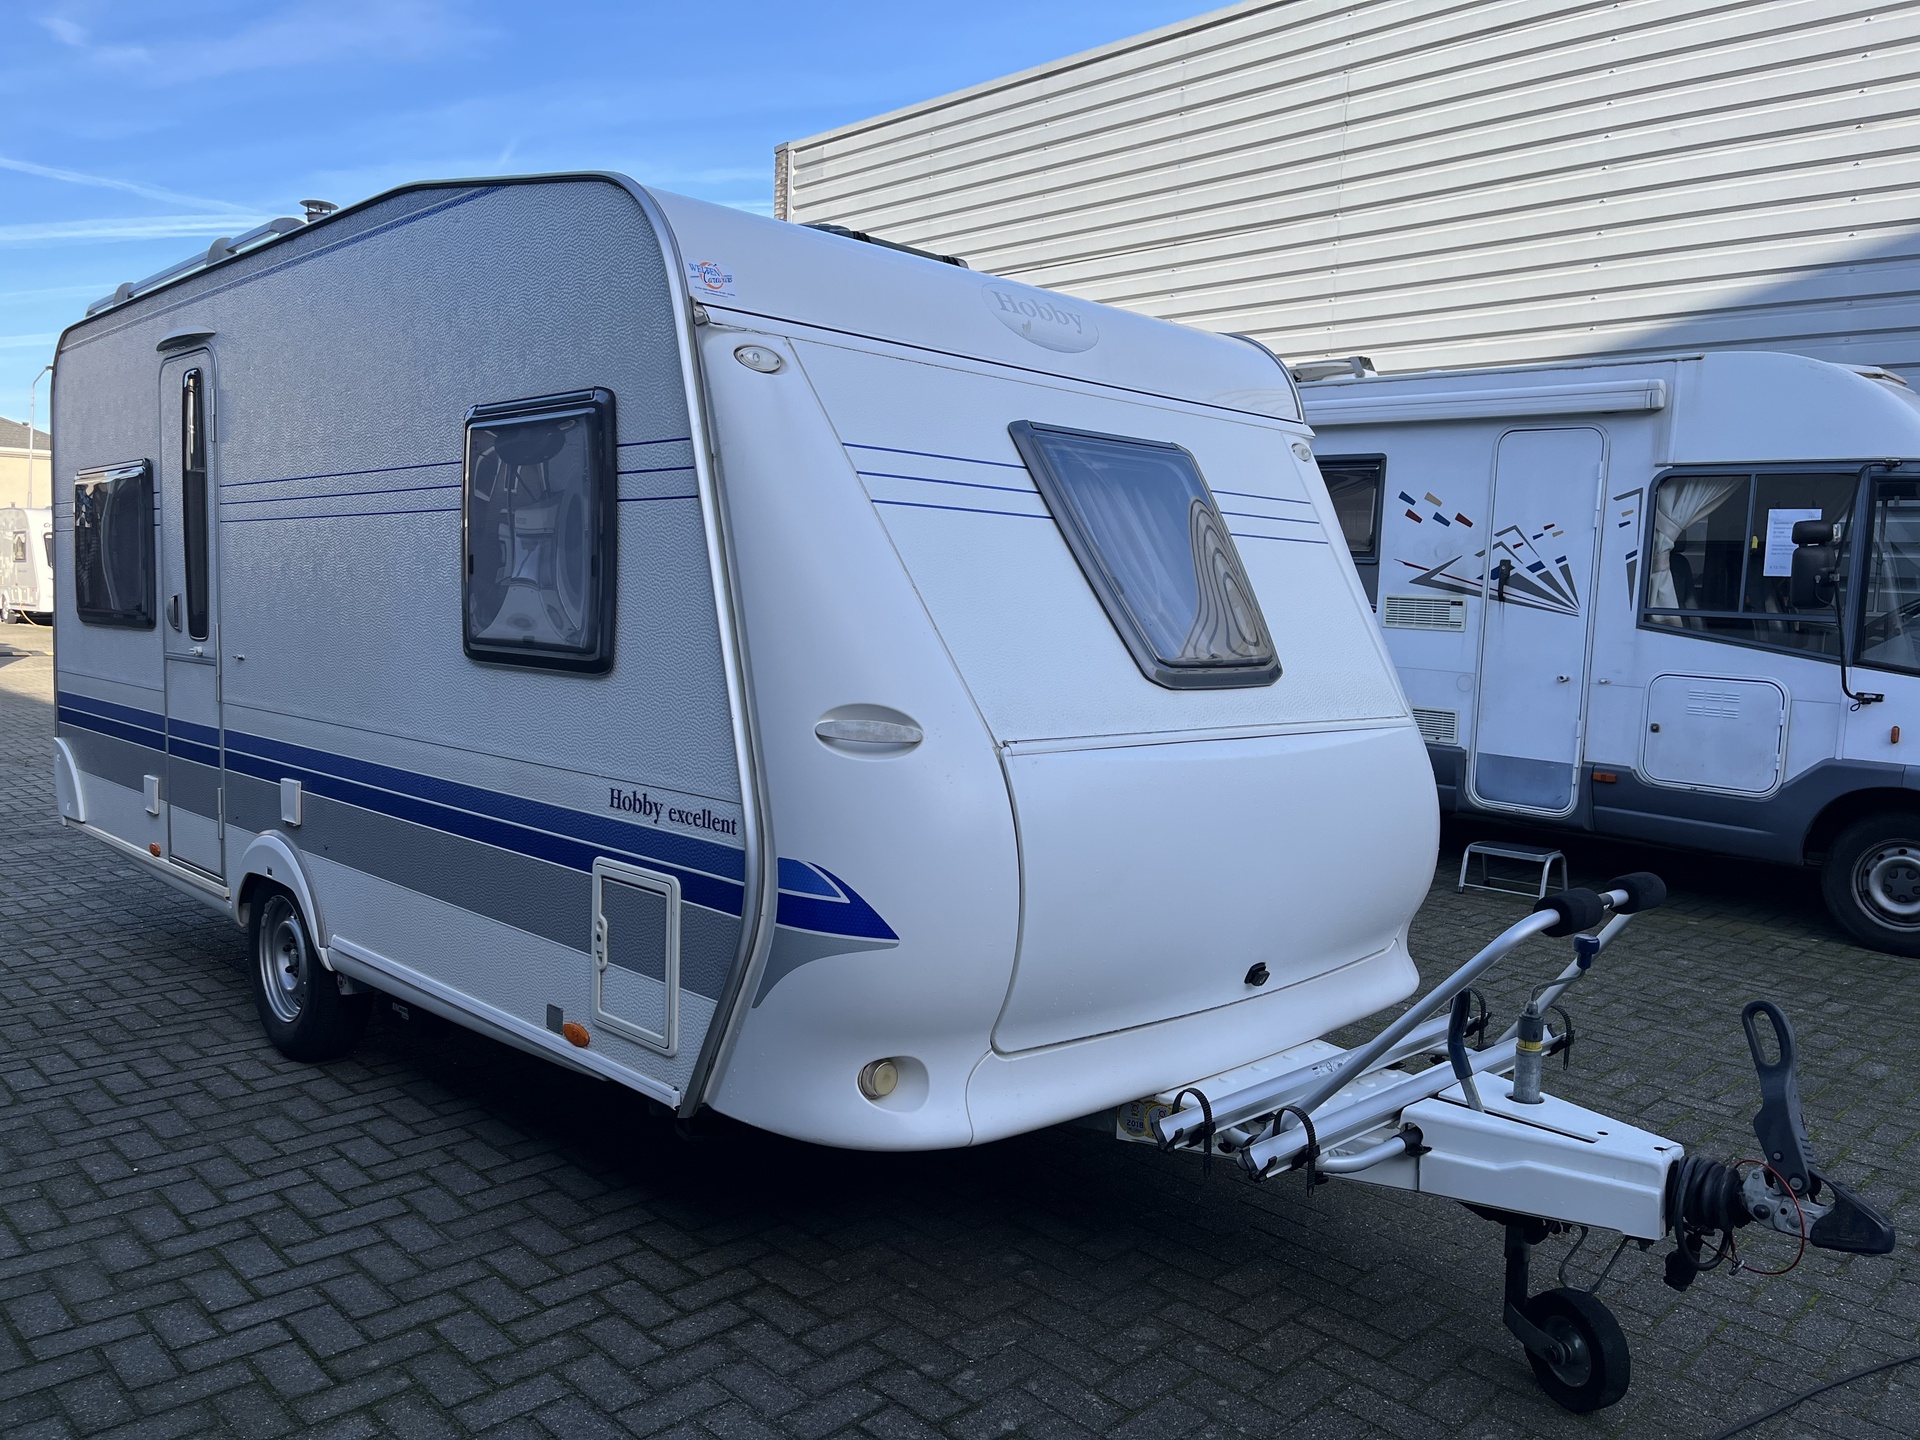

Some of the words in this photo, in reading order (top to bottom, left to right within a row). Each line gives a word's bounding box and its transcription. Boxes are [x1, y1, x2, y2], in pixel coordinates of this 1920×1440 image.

[991, 290, 1082, 334] Hobby
[609, 788, 663, 824] Hobby
[668, 807, 737, 835] excellent
[1126, 1119, 1144, 1128] 2018
